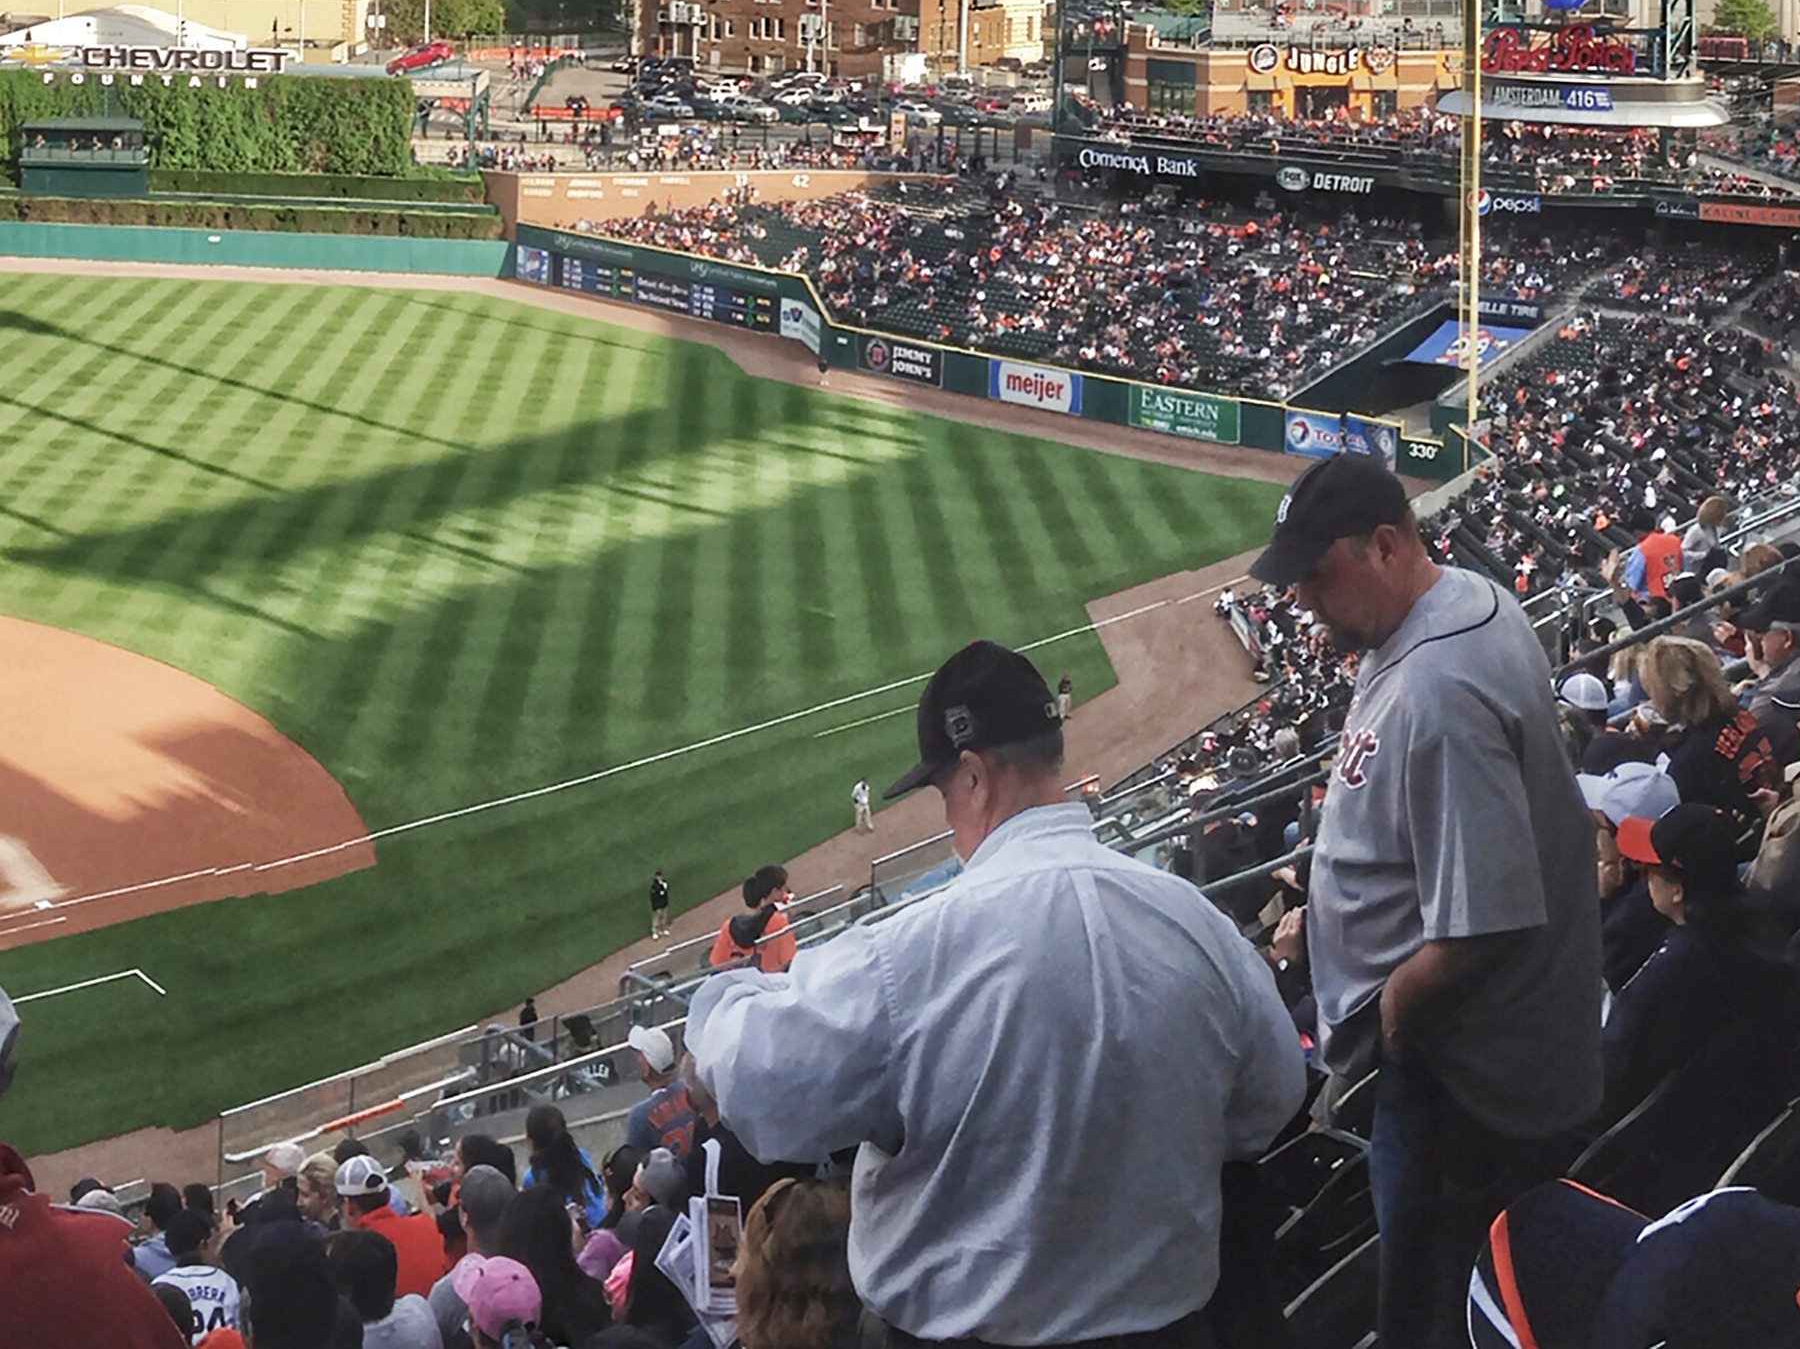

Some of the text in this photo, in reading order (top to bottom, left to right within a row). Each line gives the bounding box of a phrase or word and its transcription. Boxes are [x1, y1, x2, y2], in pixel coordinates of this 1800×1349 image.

[83, 47, 289, 72] CHEVROLET
[1288, 47, 1359, 74] JUNGLE
[43, 72, 258, 90] FOUNTAIN
[1566, 90, 1595, 109] 416
[1157, 157, 1198, 177] Bank
[791, 174, 810, 188] 42
[1282, 169, 1375, 194] FOX DETROIT
[1493, 195, 1541, 212] pepsi
[1480, 302, 1538, 318] ELLE TIRE
[892, 346, 933, 365] JIMMY
[891, 359, 933, 379] JOHN'S
[1005, 373, 1064, 402] meijer
[1141, 387, 1220, 421] EASTERN
[187, 1285, 226, 1302] BRERA
